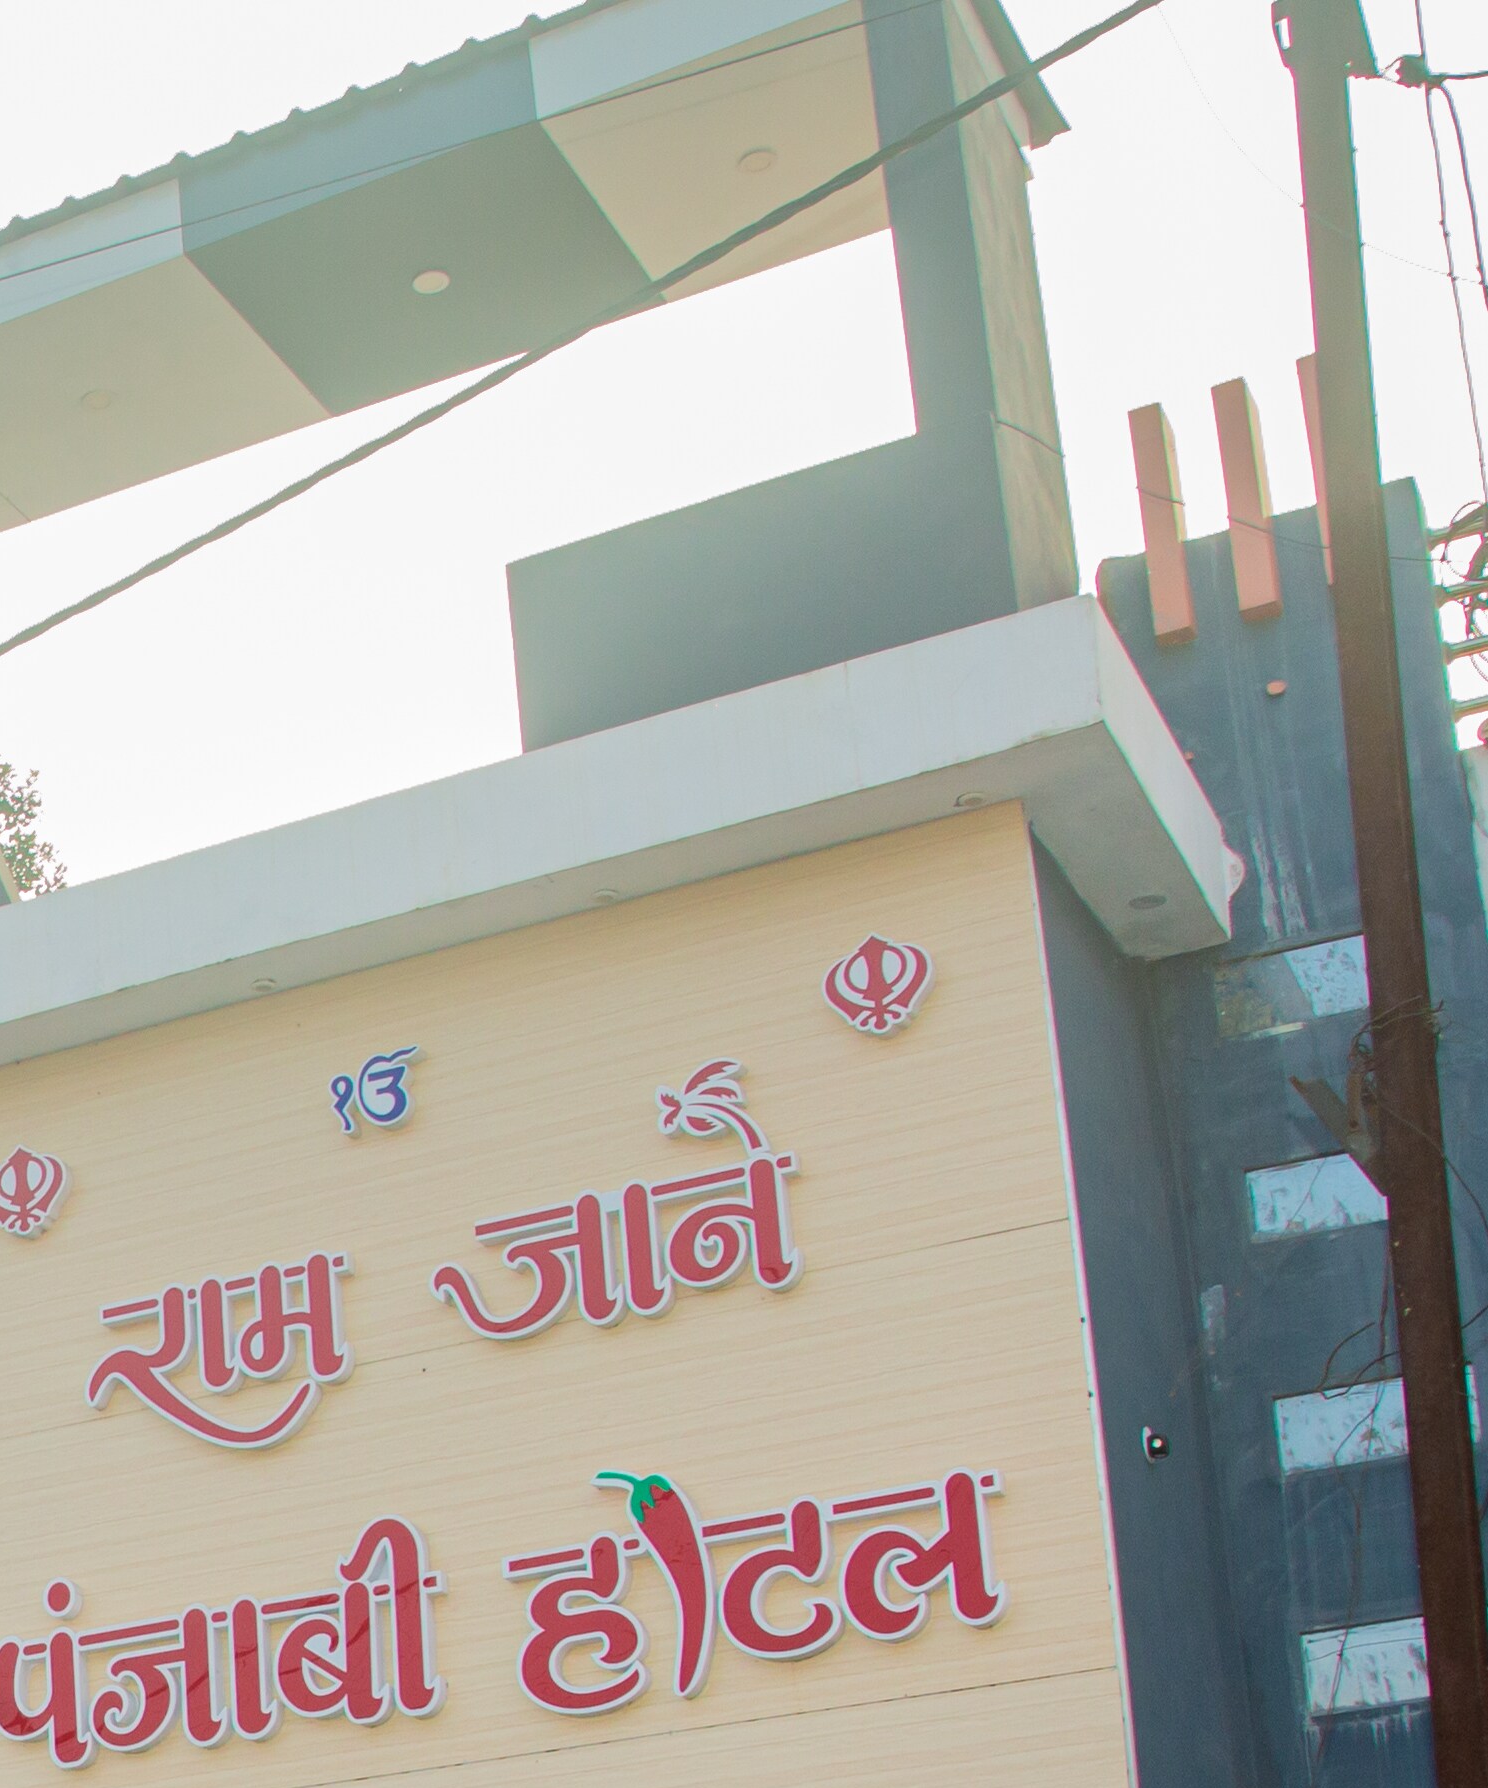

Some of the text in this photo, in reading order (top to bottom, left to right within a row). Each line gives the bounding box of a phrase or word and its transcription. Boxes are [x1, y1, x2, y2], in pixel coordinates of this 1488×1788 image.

[88, 1061, 793, 1444] राम जाने
[508, 1470, 999, 1711] होटल
